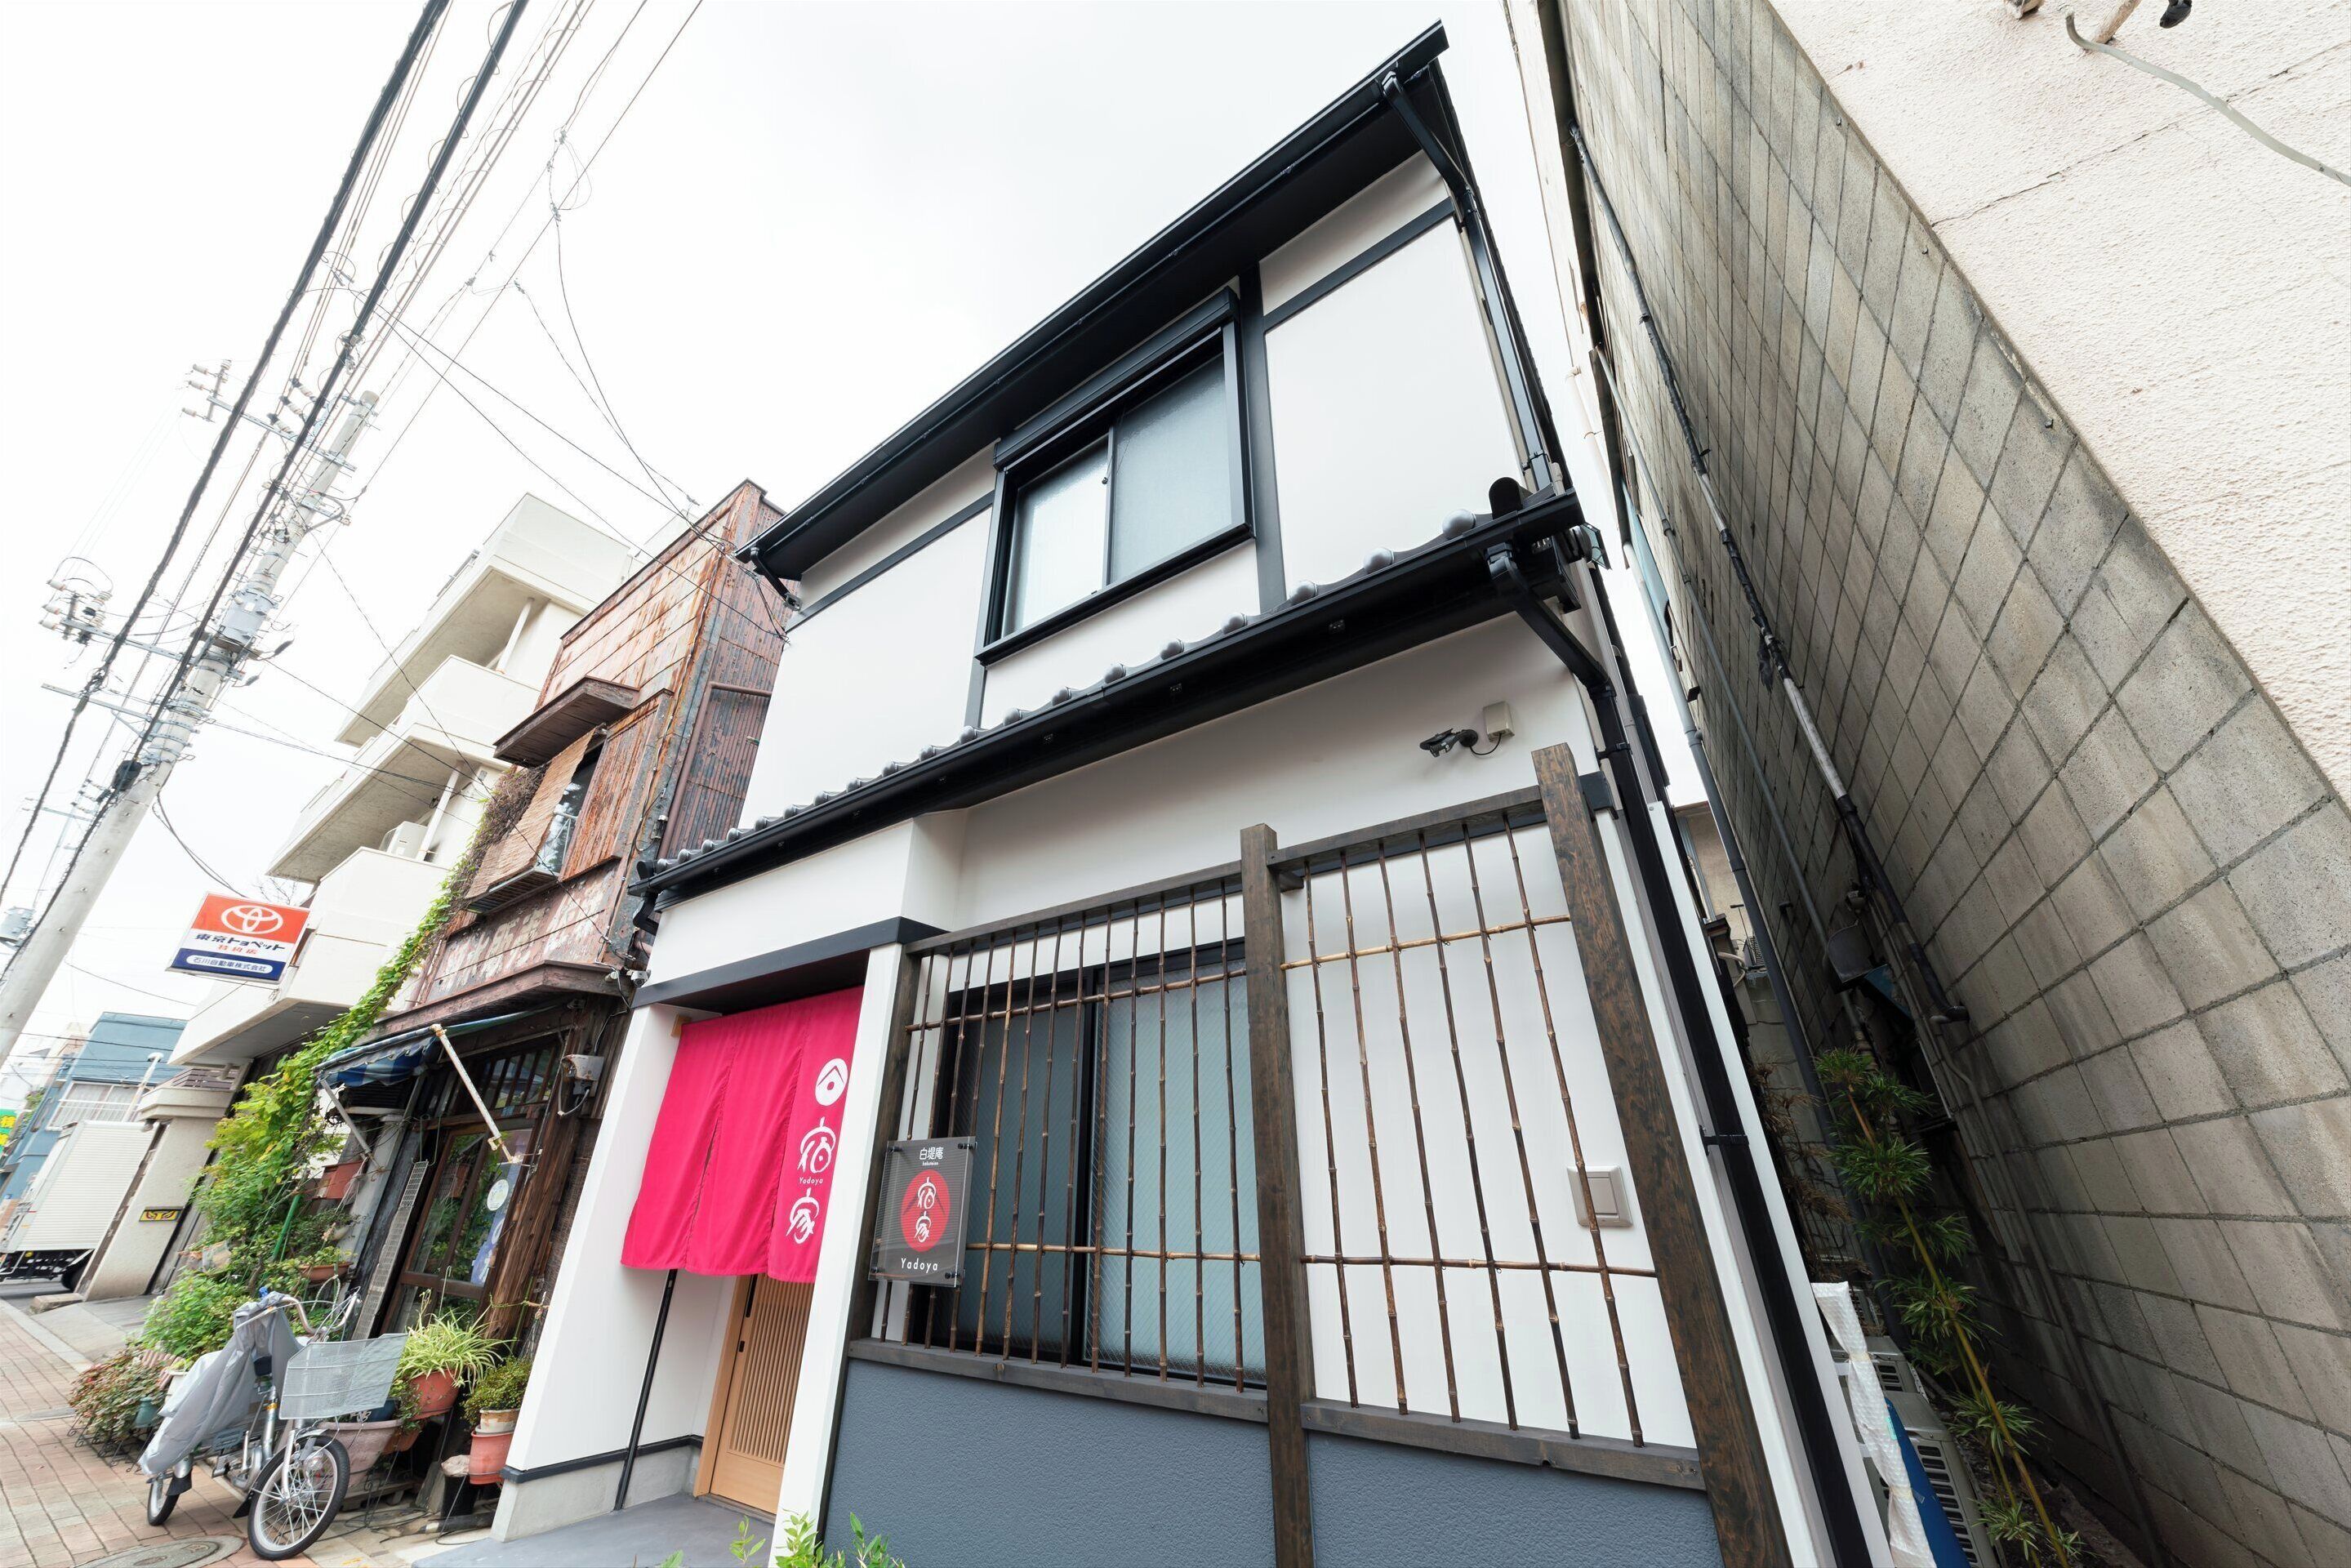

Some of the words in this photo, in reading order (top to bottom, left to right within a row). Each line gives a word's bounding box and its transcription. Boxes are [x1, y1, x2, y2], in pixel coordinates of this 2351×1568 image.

[194, 933, 286, 951] 東京トヨペット
[193, 956, 267, 973] 石川自動車株式会社
[919, 1147, 944, 1160] 白堤庵
[799, 1176, 824, 1185] Yadoya
[900, 1257, 938, 1272] Yadoya
